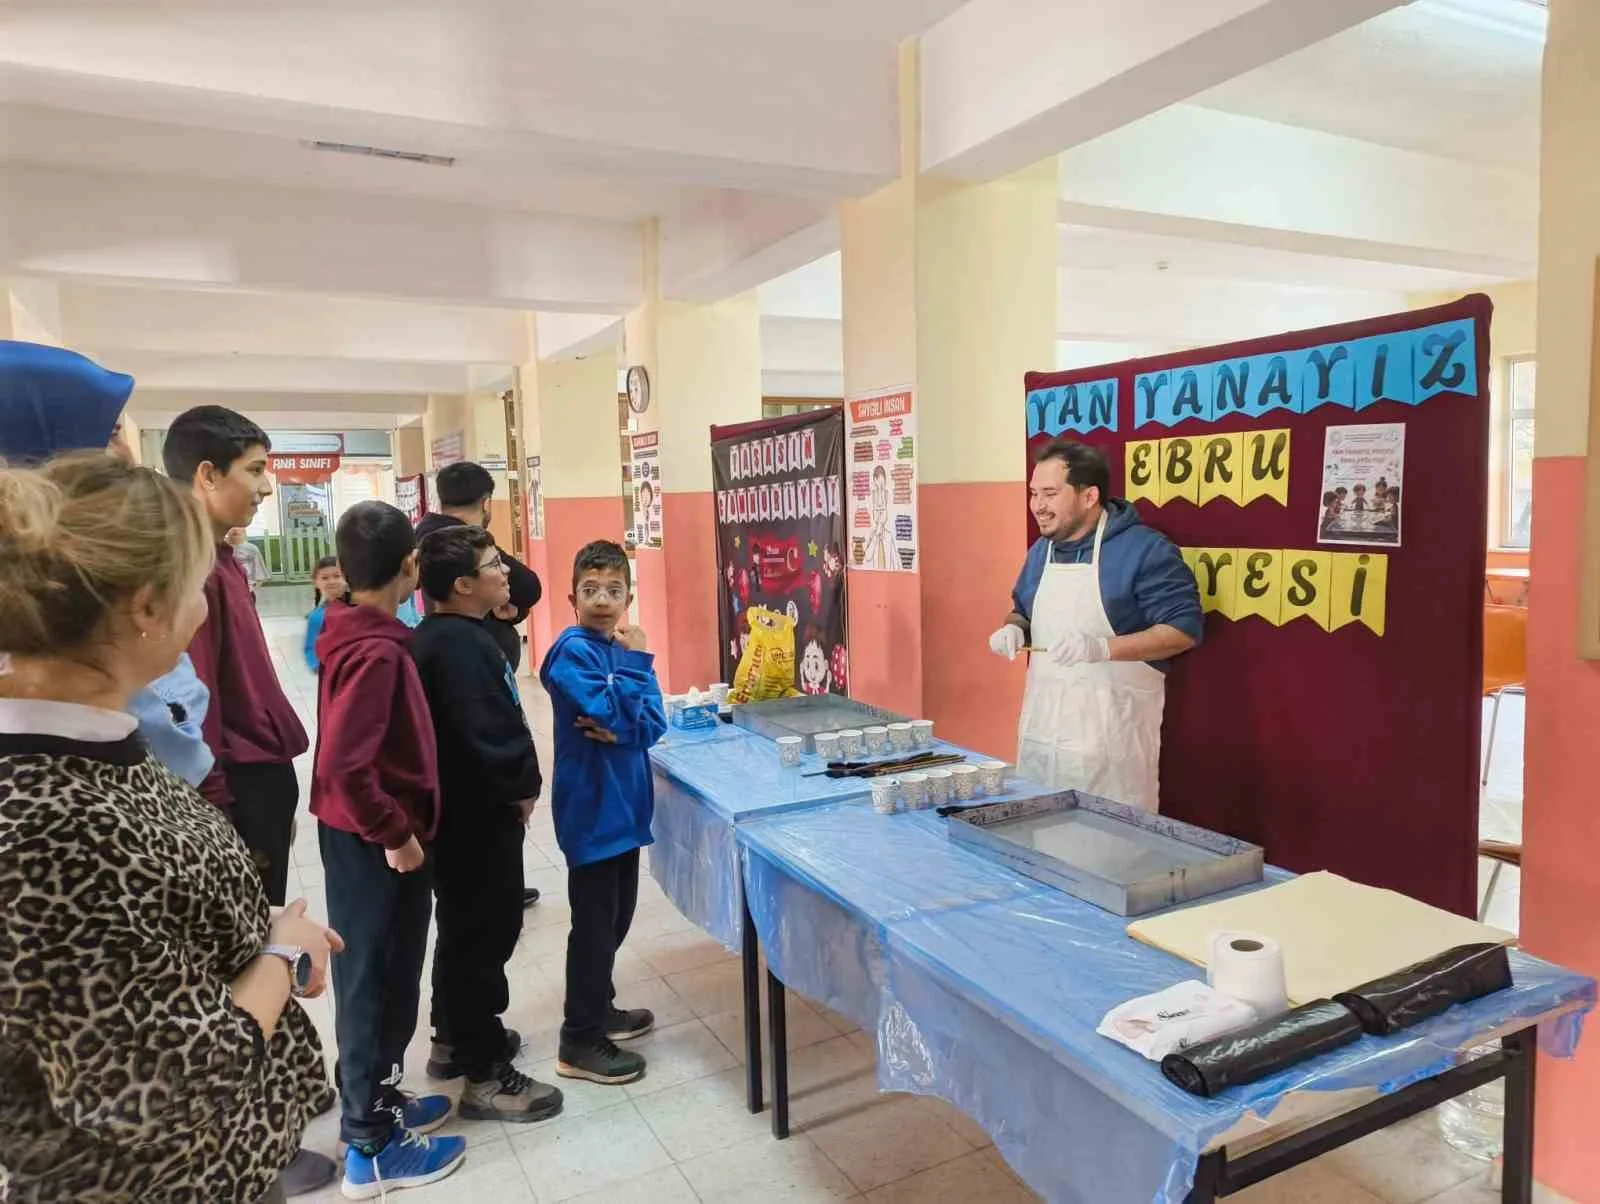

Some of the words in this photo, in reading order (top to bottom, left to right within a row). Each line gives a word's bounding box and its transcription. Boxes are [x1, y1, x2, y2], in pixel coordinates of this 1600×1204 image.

[1028, 382, 1114, 431] YAN
[1136, 329, 1467, 419] YANAYIZ
[272, 458, 297, 470] ANA
[300, 457, 332, 470] SINIFI
[1129, 432, 1288, 486] EBRU
[1198, 551, 1371, 617] YESİ
